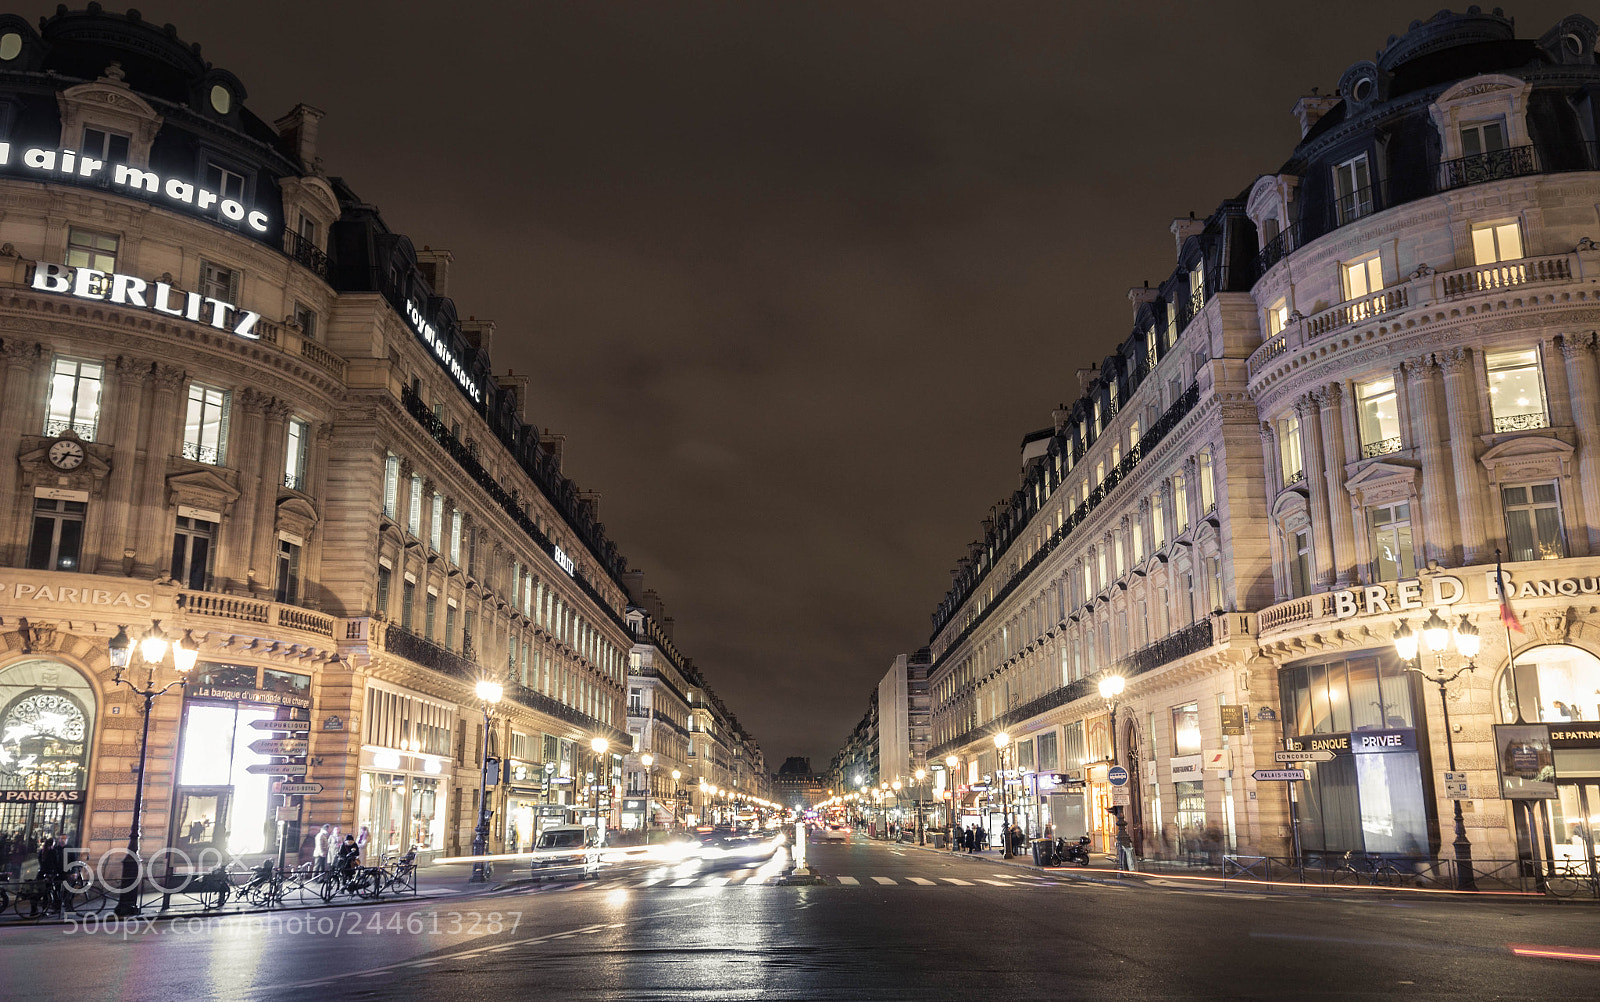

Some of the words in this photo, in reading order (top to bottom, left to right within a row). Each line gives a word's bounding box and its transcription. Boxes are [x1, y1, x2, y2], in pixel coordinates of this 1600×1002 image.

[24, 148, 103, 177] air
[114, 164, 268, 232] maroc
[31, 260, 261, 340] BERLITZ
[406, 298, 436, 348] royal
[435, 339, 452, 366] air
[451, 358, 481, 403] maroc
[14, 583, 151, 609] PARIBAS
[1334, 576, 1465, 619] BRED
[1485, 569, 1600, 600] BANQU
[199, 687, 210, 697] La
[211, 687, 240, 700] banque
[281, 696, 292, 706] qui
[291, 696, 310, 708] change
[1311, 737, 1349, 751] BANQUE
[1361, 734, 1402, 748] PRIVEE
[1551, 731, 1565, 740] DE
[1565, 730, 1600, 740] PATRIM
[6, 791, 79, 801] PARIBAS
